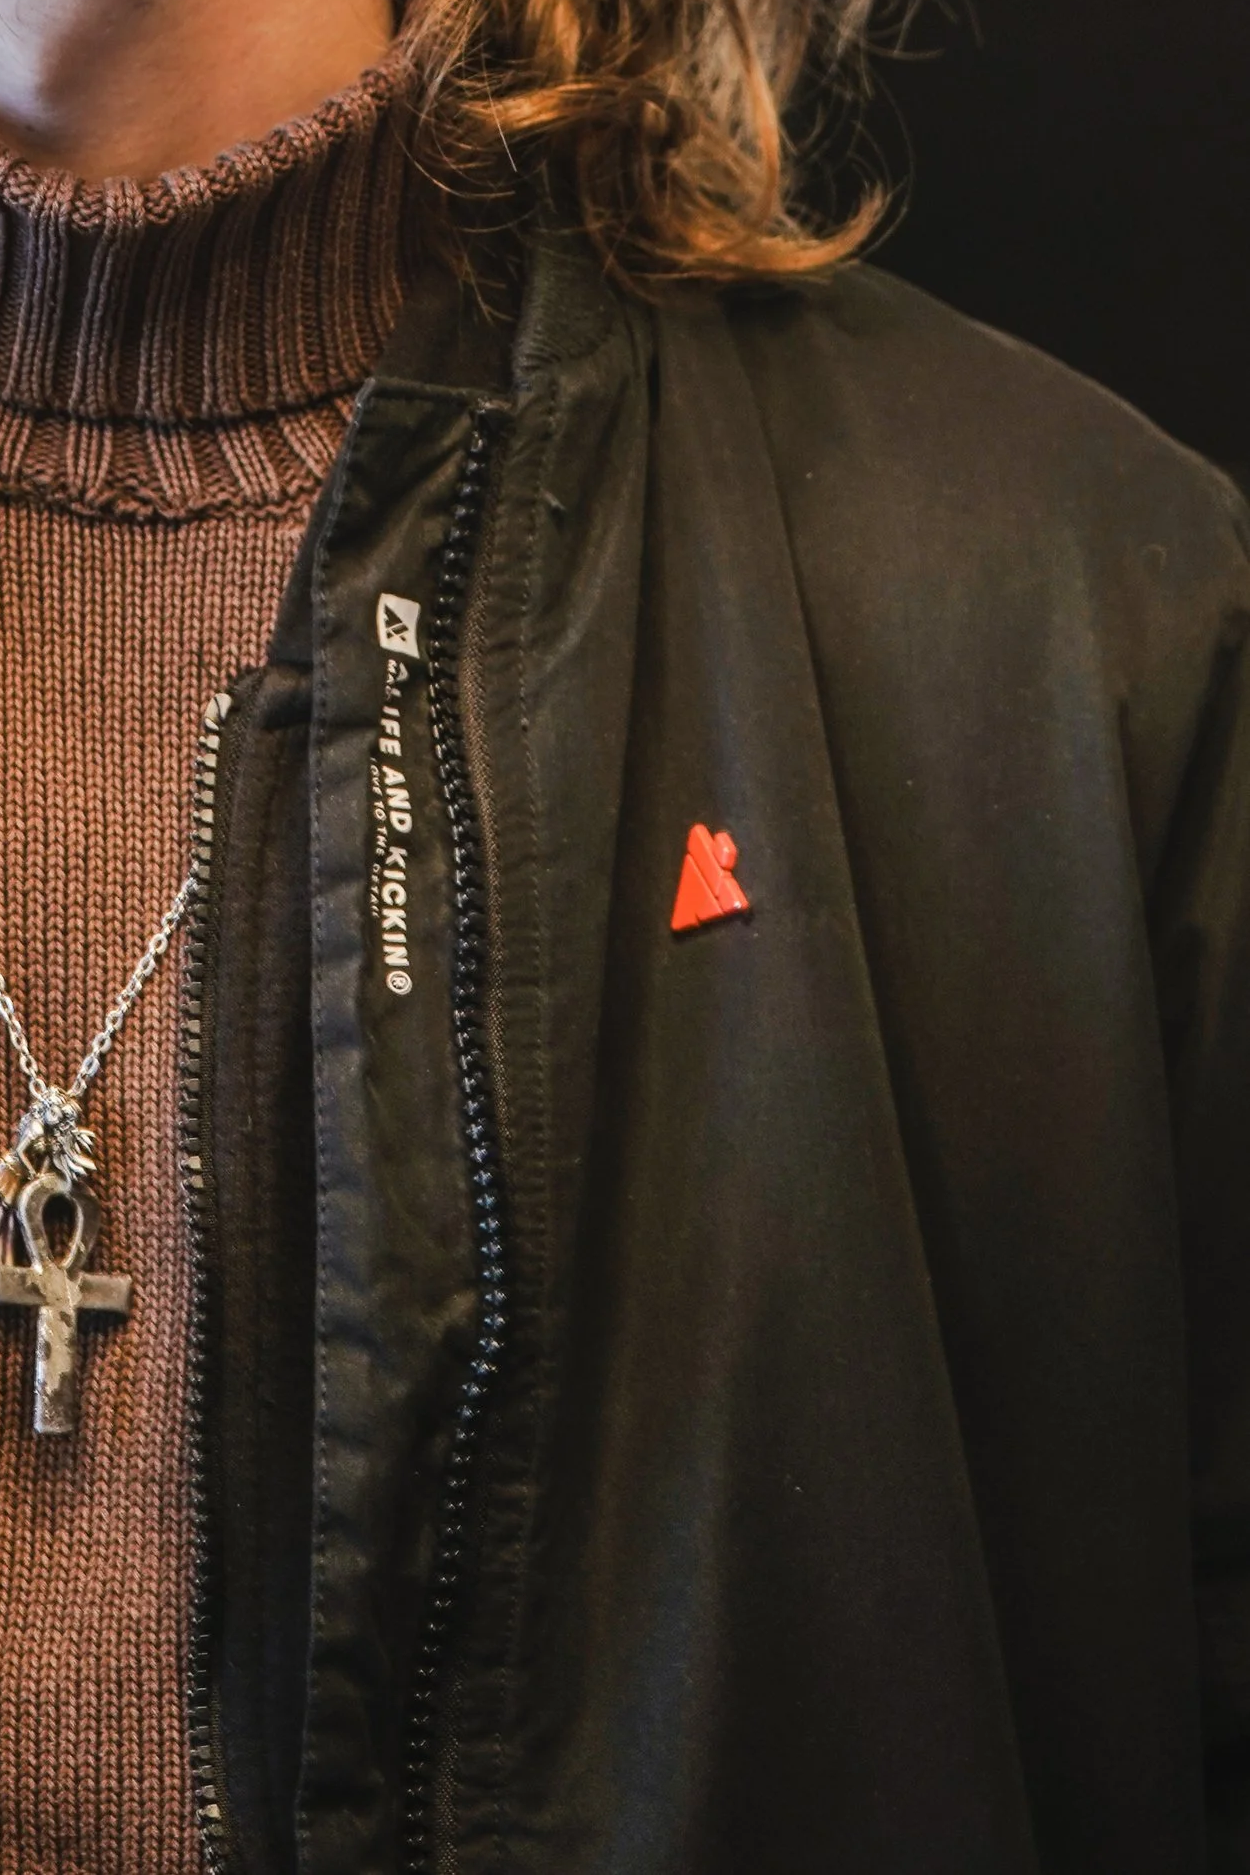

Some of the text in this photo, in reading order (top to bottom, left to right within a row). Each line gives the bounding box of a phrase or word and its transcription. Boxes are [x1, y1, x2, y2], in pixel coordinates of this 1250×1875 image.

[373, 801, 387, 822] TO
[382, 765, 411, 833] AND
[376, 826, 388, 856] THE
